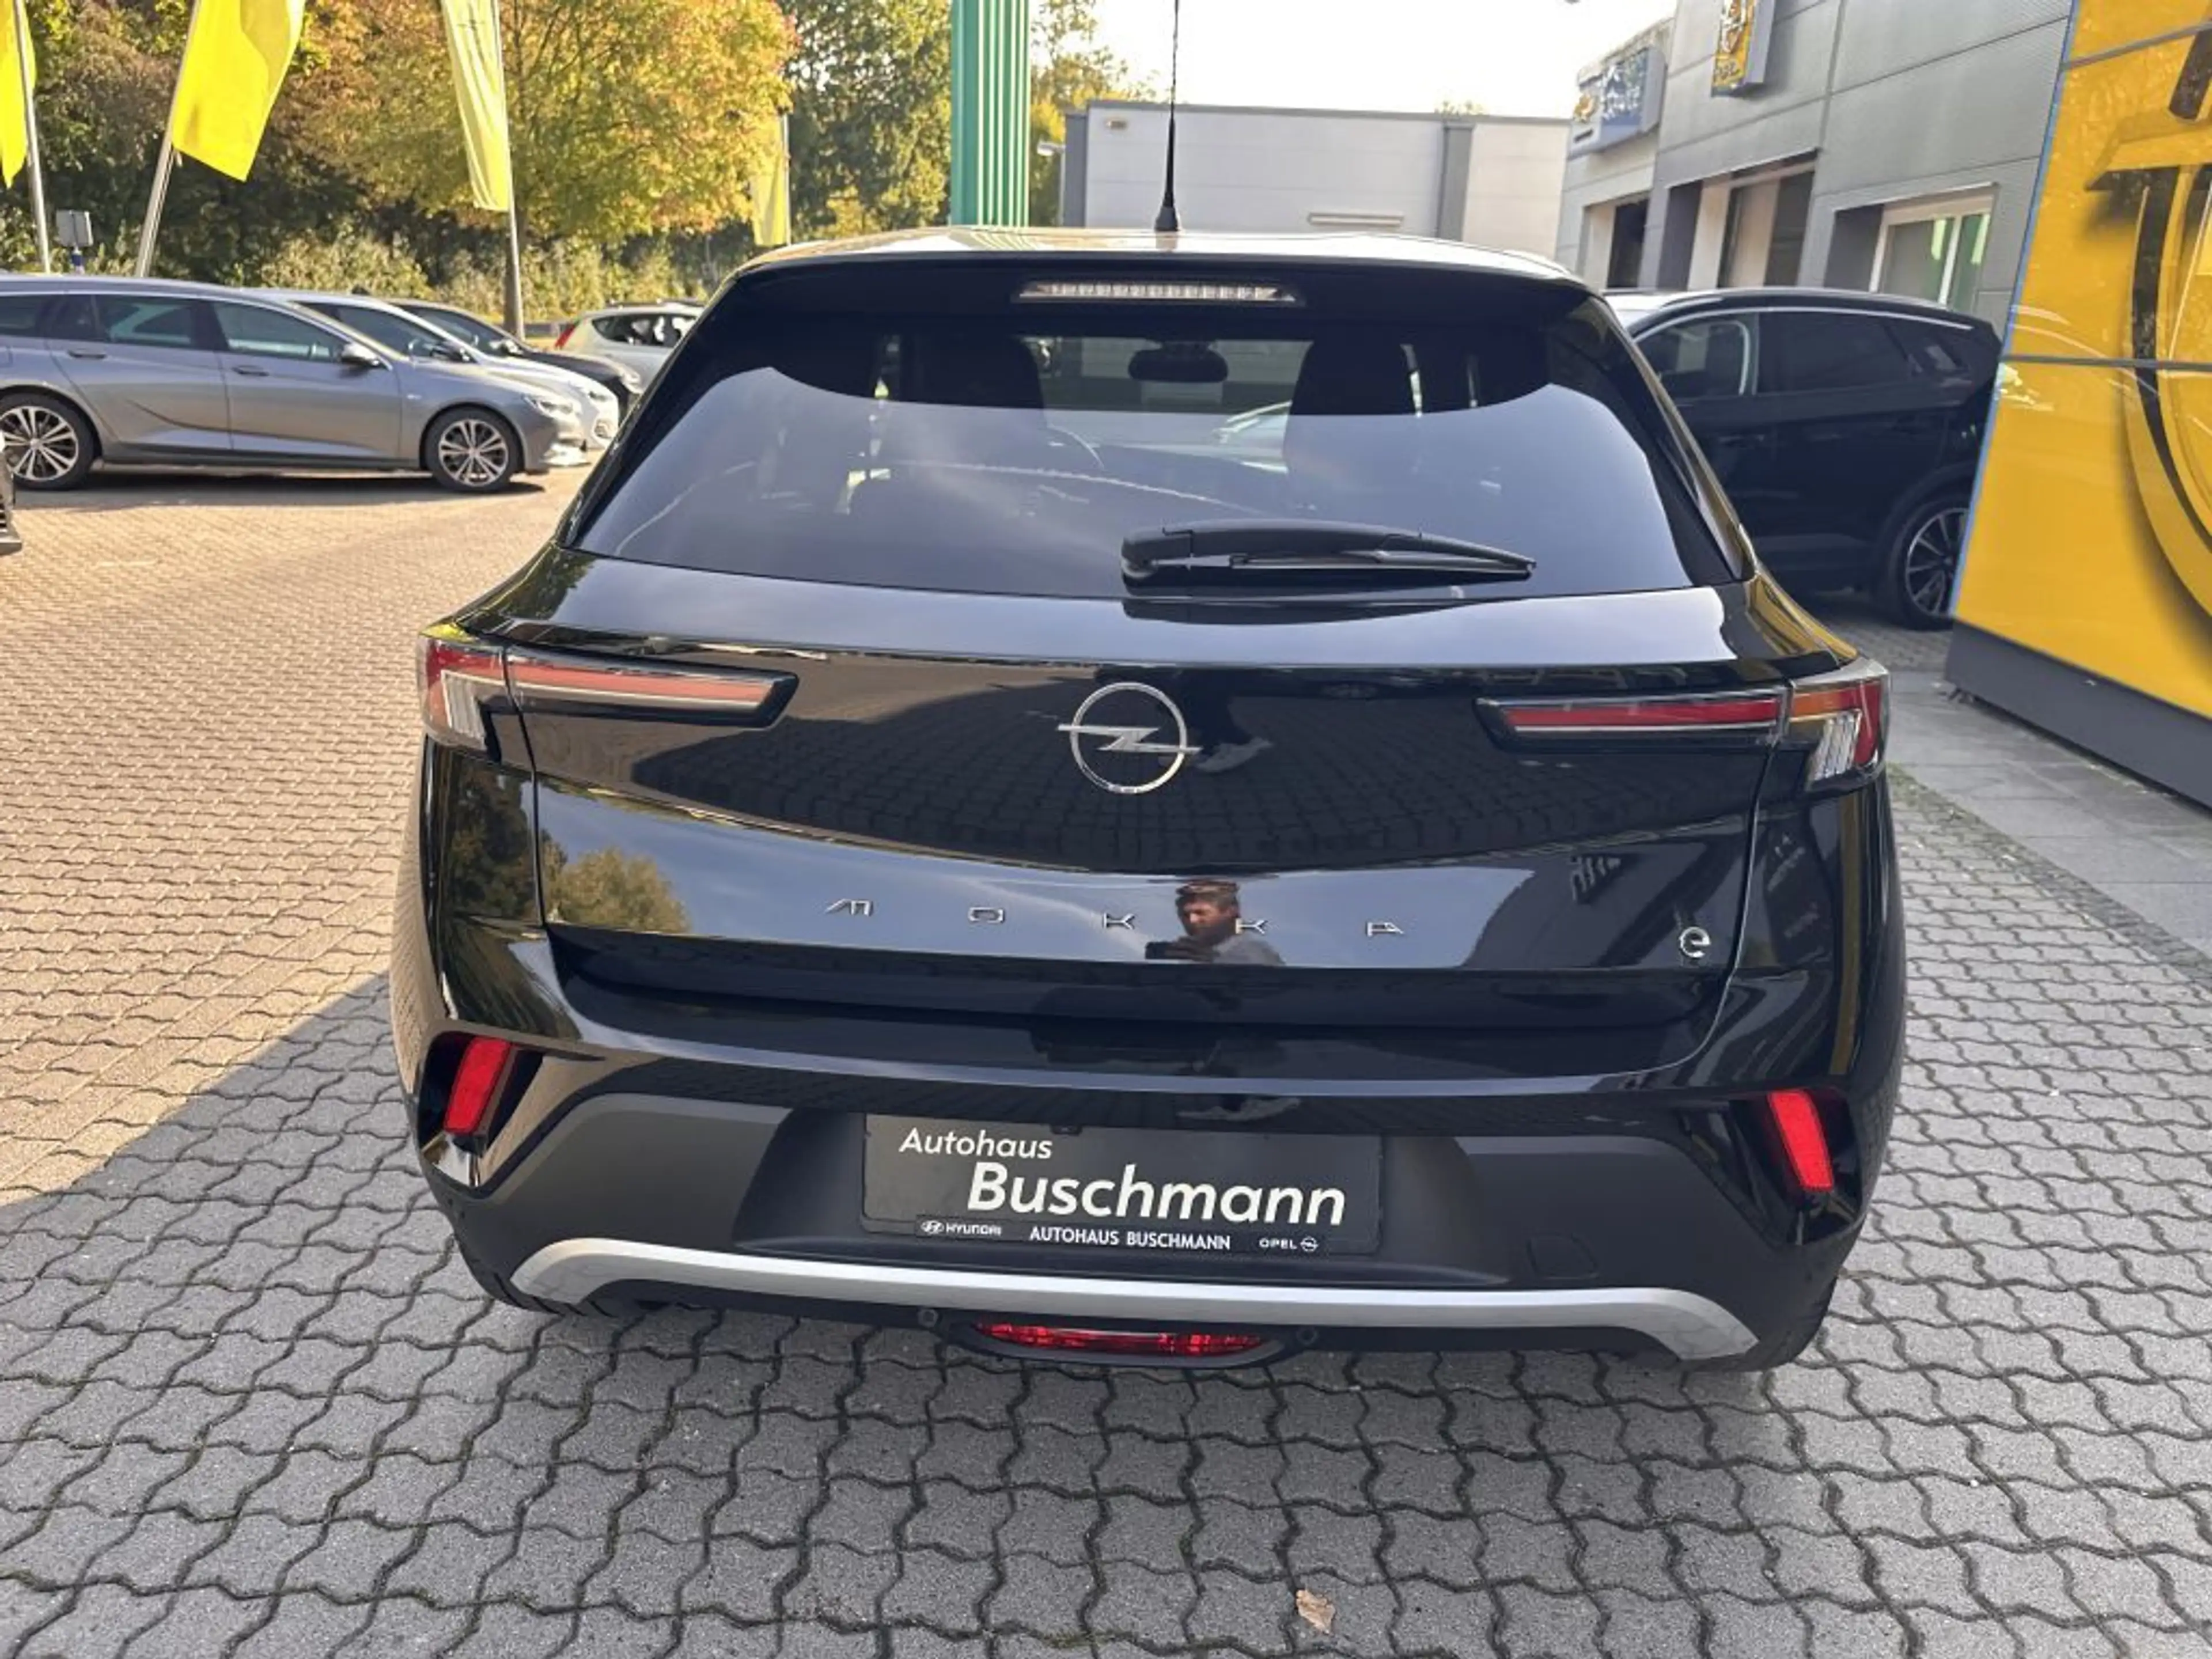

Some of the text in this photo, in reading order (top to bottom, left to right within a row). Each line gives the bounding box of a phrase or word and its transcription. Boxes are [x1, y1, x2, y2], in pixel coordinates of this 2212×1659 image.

[825, 898, 1404, 937] MOKKA
[1679, 926, 1711, 958] e
[899, 1127, 1052, 1160] Autohaus
[968, 1161, 1346, 1226] Buschmann
[946, 1222, 1002, 1236] HYUNDAI
[1029, 1225, 1231, 1251] AUTOHAUS BUSCHMANN
[1259, 1237, 1297, 1250] OPEL
